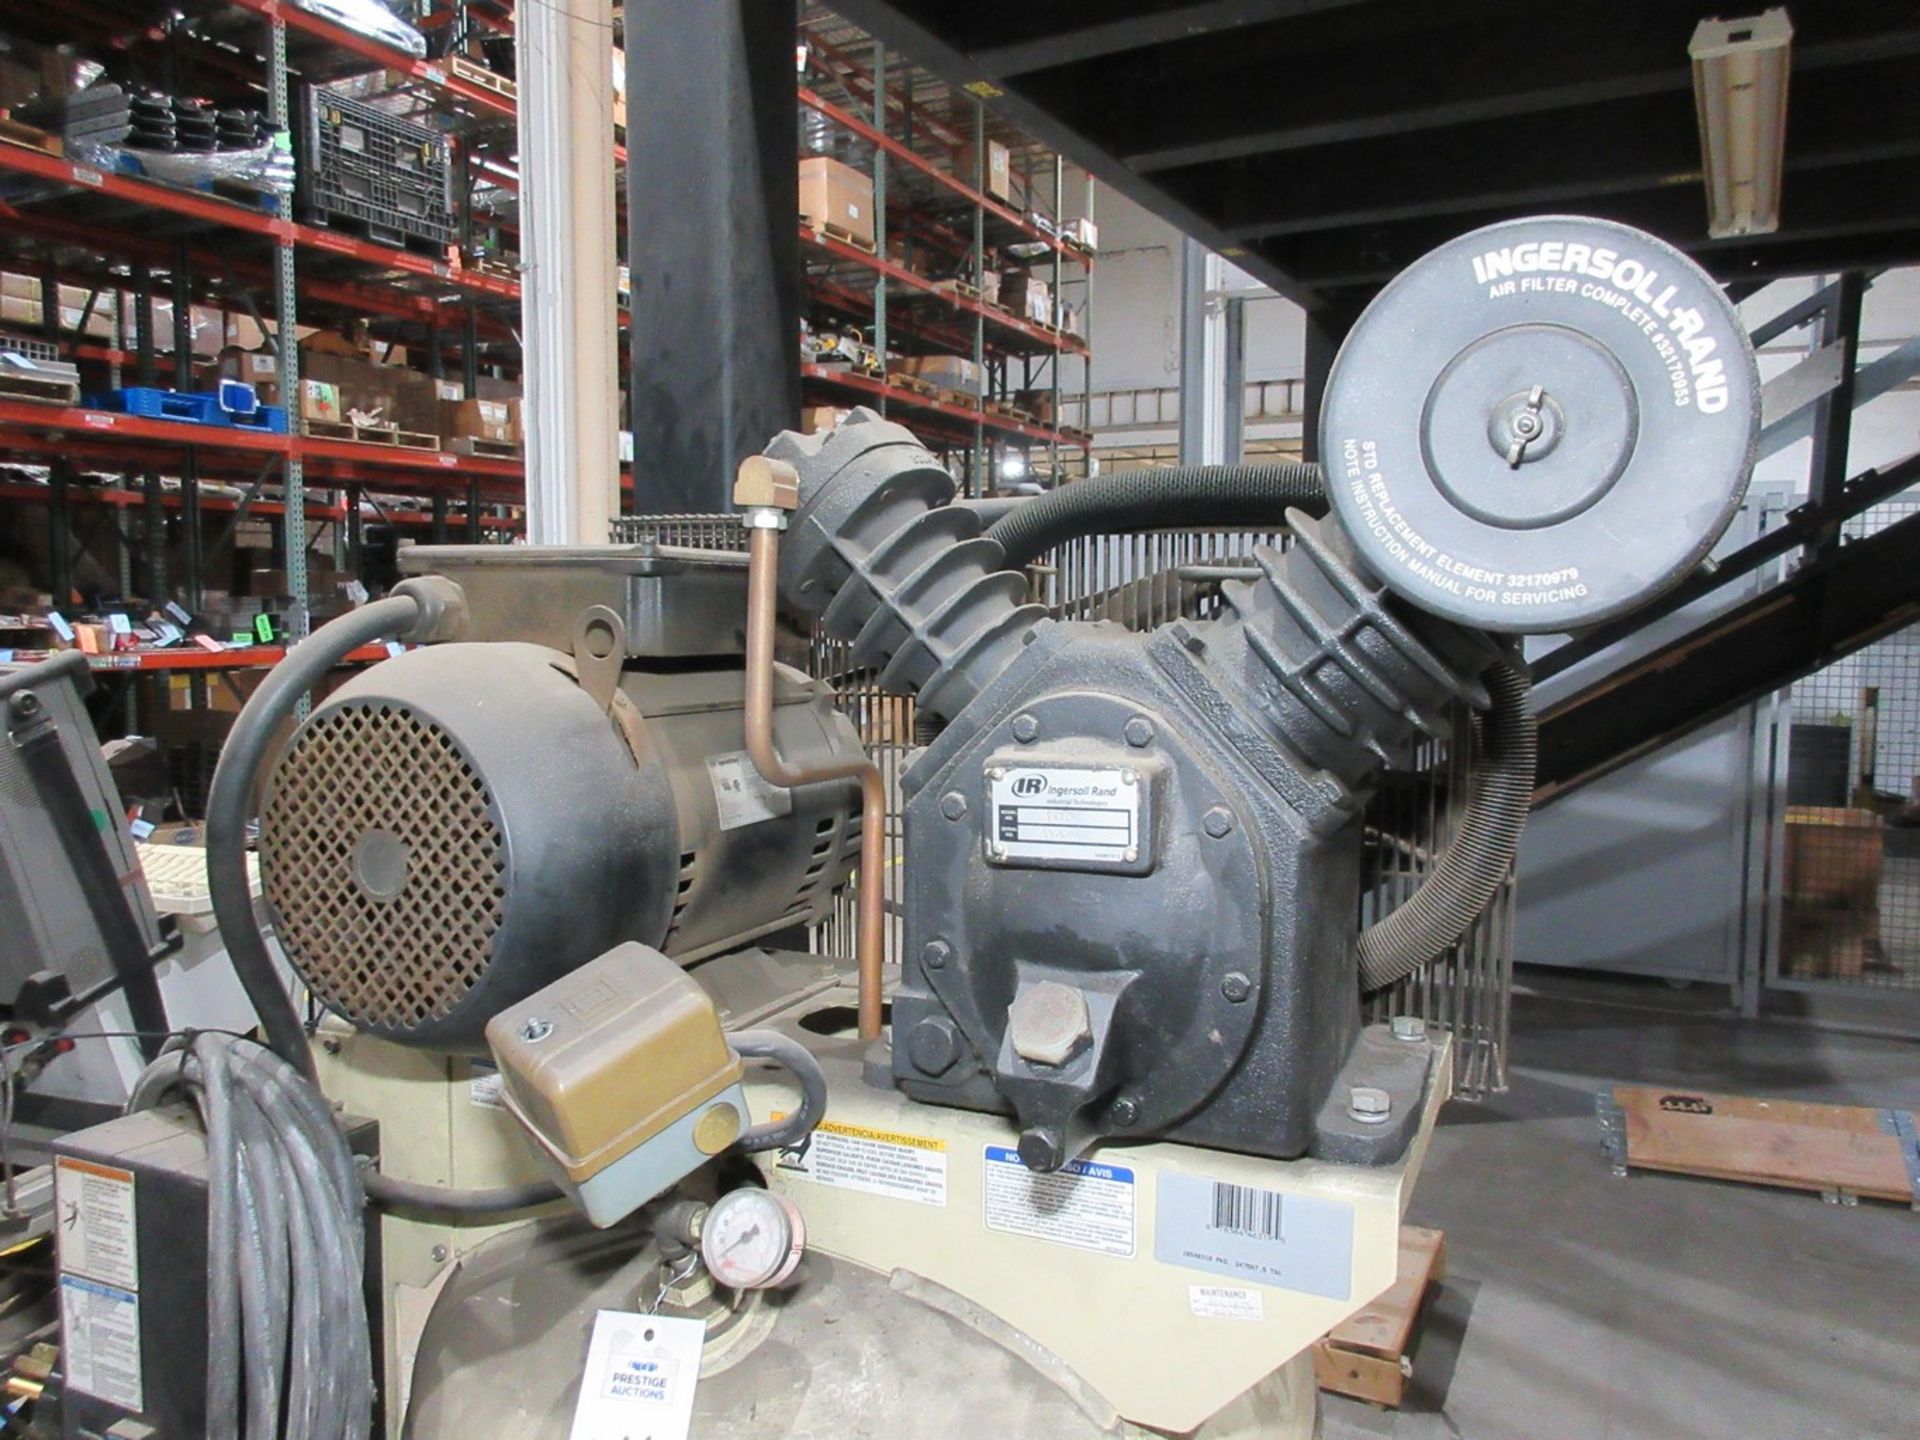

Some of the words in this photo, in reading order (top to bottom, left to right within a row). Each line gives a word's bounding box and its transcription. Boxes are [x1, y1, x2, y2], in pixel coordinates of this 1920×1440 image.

[1489, 283, 1516, 299] AIR
[1520, 277, 1576, 294] FILTER
[1581, 282, 1655, 336] COMPLETE
[1472, 242, 1728, 414] INGERSOLL-RAND
[1343, 438, 1363, 484] NOTE
[1362, 440, 1377, 474] STD
[1349, 484, 1409, 563] INSTRUCTION
[1368, 475, 1437, 558] REPLACEMENT
[1407, 558, 1461, 595] MANUAL
[1435, 553, 1504, 586] ELEMENT
[1507, 567, 1579, 588] 32170979
[1465, 586, 1497, 604] FOR
[1502, 583, 1588, 605] SERVICING
[1016, 778, 1042, 793] IR
[1047, 785, 1090, 797] Ingersoll
[1092, 786, 1117, 797] Rand
[1088, 1167, 1113, 1179] AVIS
[1200, 1288, 1247, 1300] MAINTENANCE
[610, 1385, 664, 1400] AUCTIONS
[612, 1372, 668, 1389] PRESTIGE
